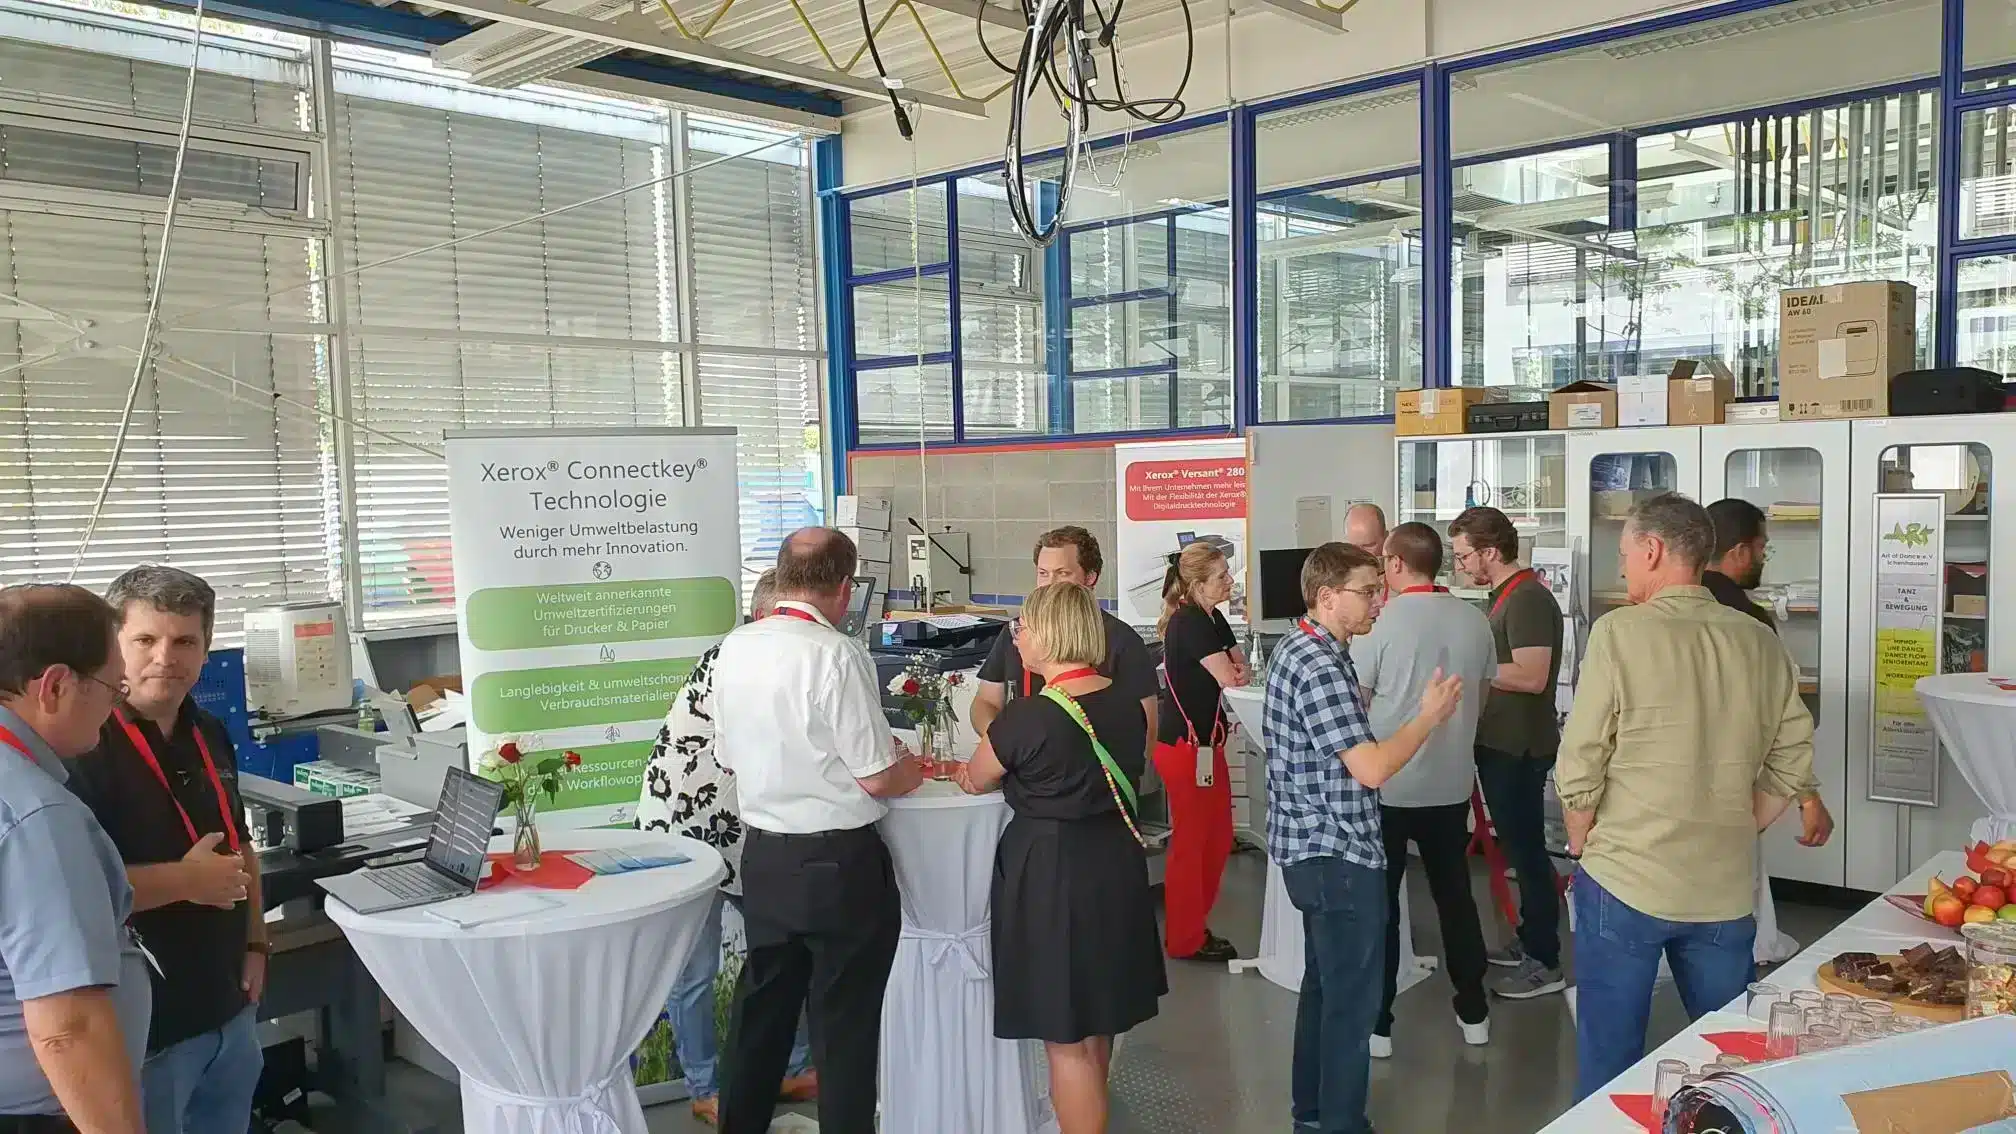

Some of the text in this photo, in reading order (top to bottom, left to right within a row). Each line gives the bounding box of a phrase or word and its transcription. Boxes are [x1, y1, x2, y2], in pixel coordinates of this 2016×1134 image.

[1226, 467, 1245, 477] 280
[529, 488, 667, 513] Technologie
[1206, 491, 1218, 499] der
[500, 520, 699, 541] Weniger Umweltbelastung
[514, 541, 688, 559] durch mehr Innovation.
[536, 587, 672, 604] Weltweit annerkannte
[533, 602, 677, 621] Umweltzertifizierungen
[1885, 603, 1928, 612] BEWEGUNG
[543, 618, 670, 636] für Drucker & Papier
[500, 679, 585, 700] Langlebigkeit
[588, 679, 600, 691] &
[540, 689, 677, 711] Verbrauchsmaterialien
